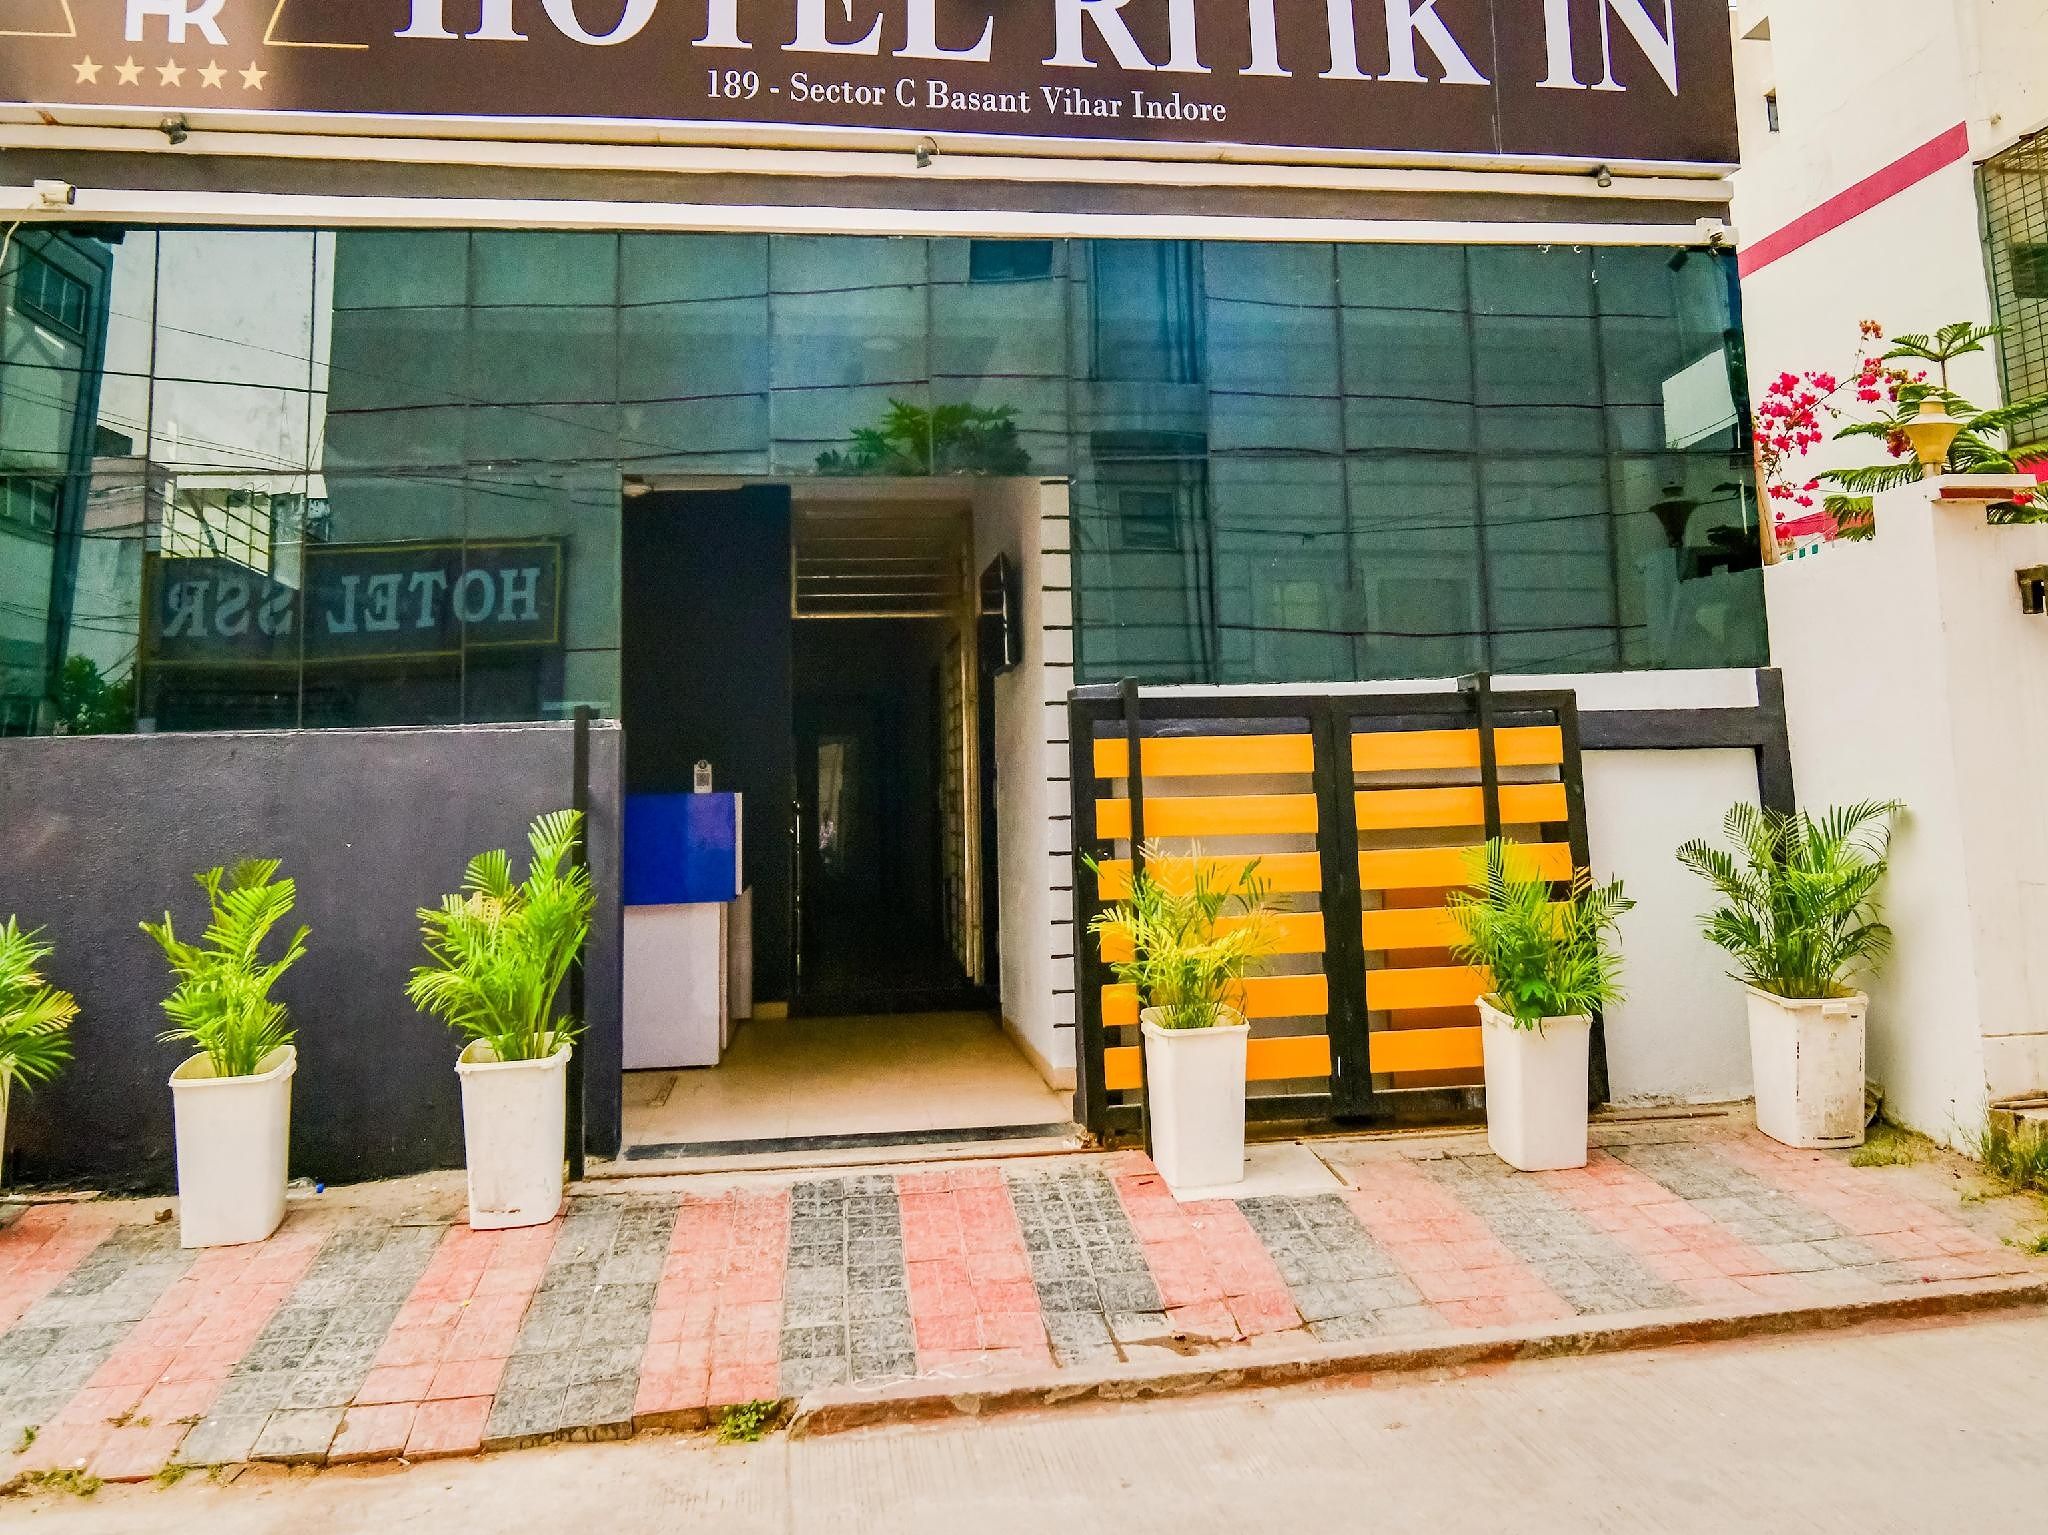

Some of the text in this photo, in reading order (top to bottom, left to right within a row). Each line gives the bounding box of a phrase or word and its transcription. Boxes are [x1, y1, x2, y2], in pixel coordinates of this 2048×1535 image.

[707, 69, 760, 99] 189
[790, 72, 886, 106] Sector
[895, 78, 916, 108] C
[926, 80, 1031, 114] Basant
[1039, 86, 1123, 118] Vihar
[1131, 90, 1227, 122] Indore
